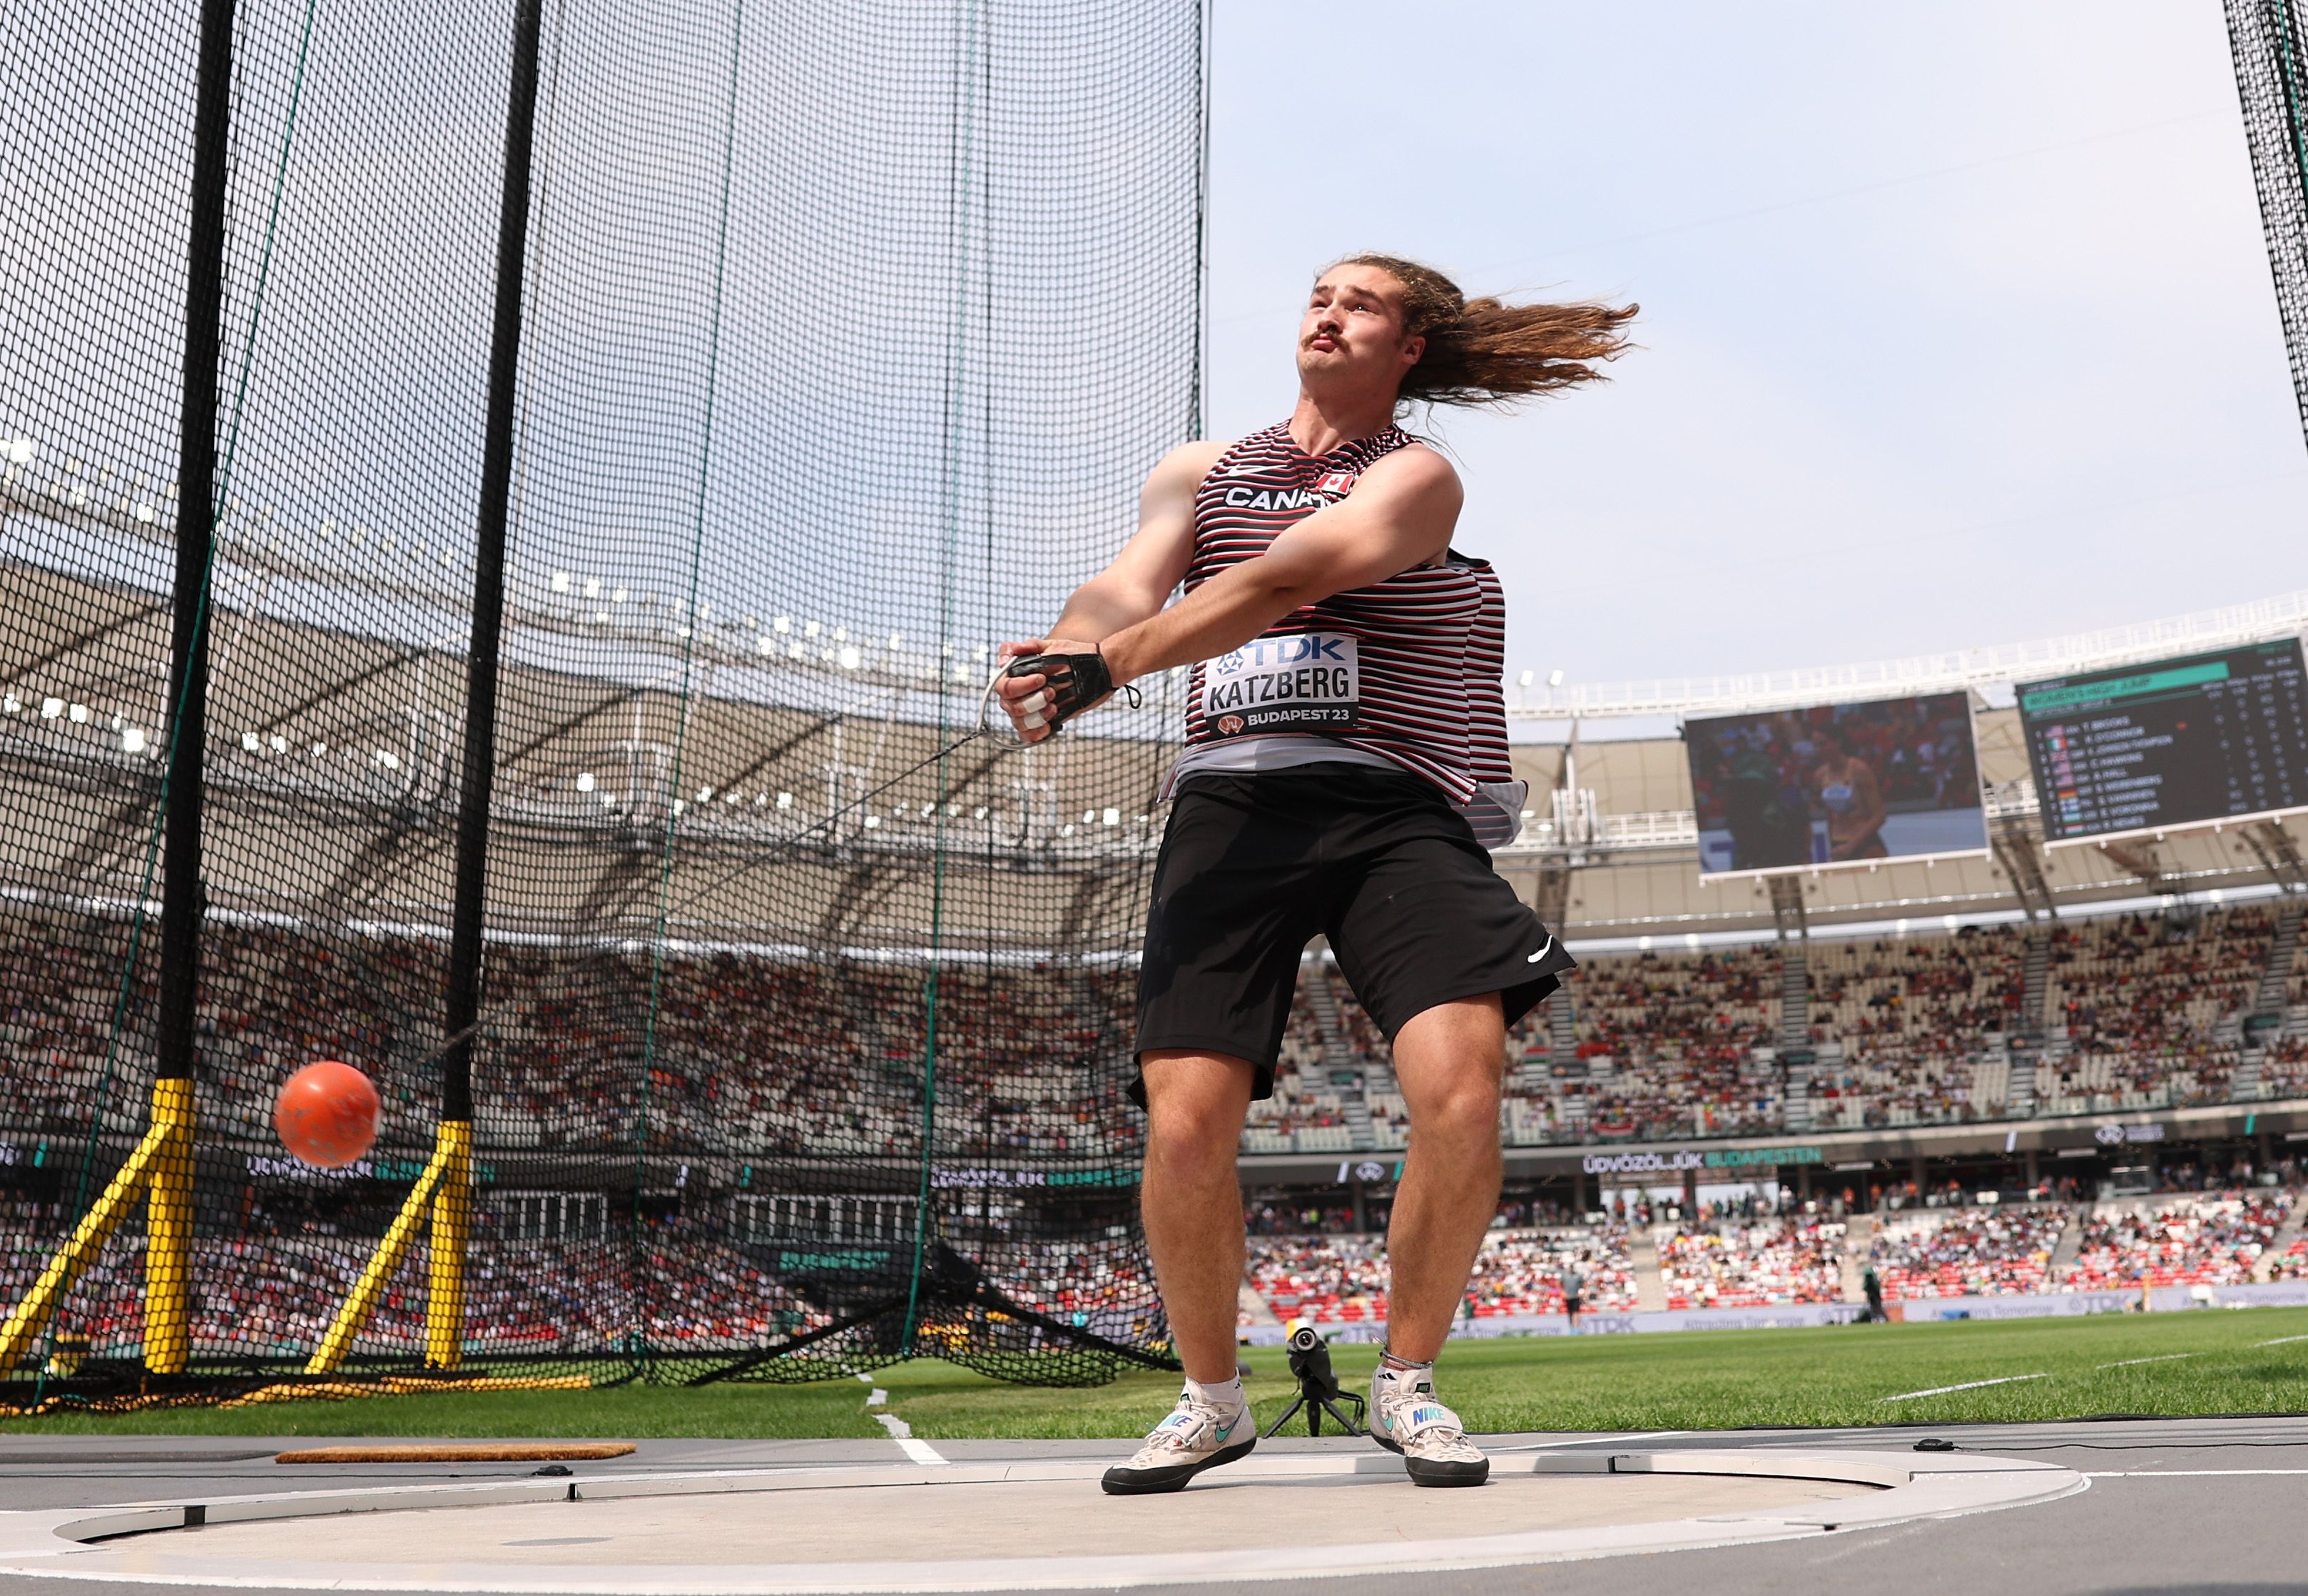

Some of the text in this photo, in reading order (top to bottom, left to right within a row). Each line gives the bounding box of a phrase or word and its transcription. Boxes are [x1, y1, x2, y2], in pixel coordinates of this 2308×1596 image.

[1225, 487, 1332, 512] CANAD
[1244, 636, 1346, 666] TDK
[1209, 667, 1349, 712] KATZBERG
[1247, 709, 1350, 726] BUDAPEST 23
[1705, 1147, 1822, 1168] BUDAPESTEN
[1413, 1406, 1445, 1427] NIKE
